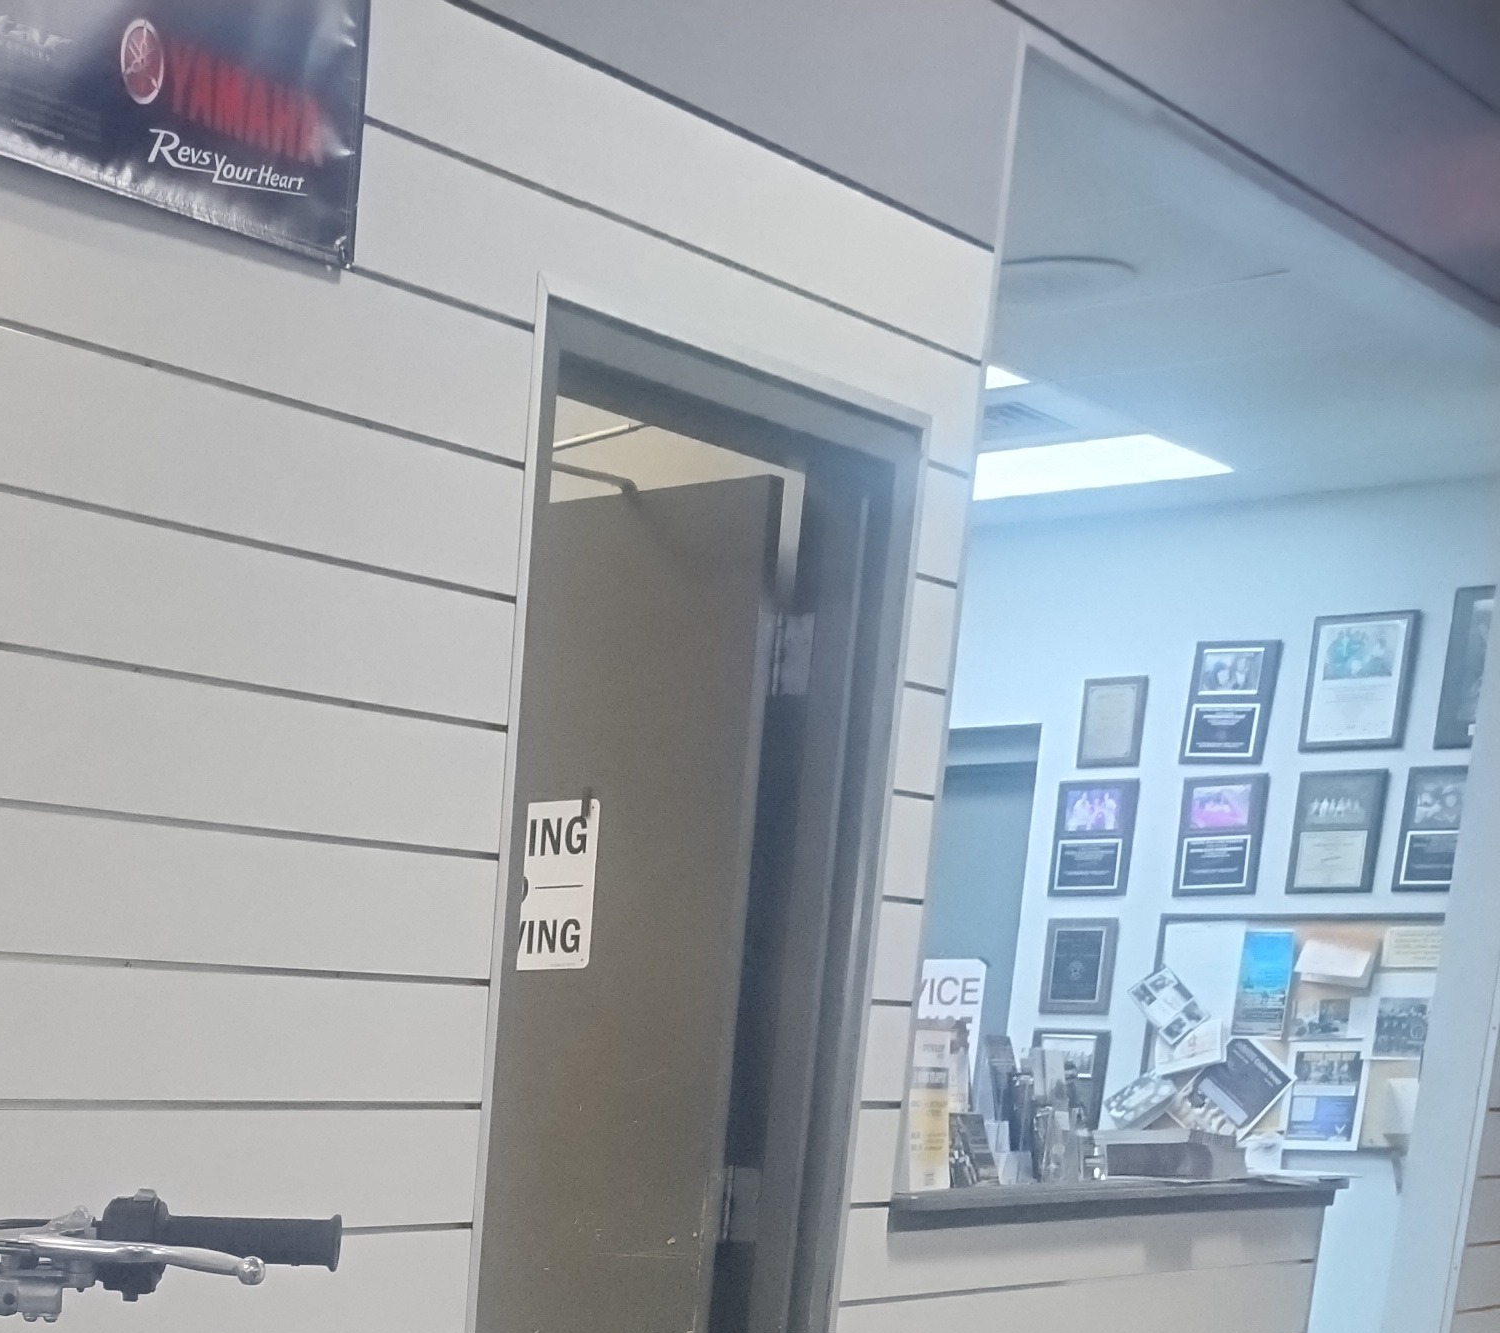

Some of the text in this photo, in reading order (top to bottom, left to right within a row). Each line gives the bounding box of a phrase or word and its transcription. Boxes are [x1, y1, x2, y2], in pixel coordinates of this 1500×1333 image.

[170, 44, 324, 167] YAMAHA
[148, 128, 305, 191] Revs Your Heart
